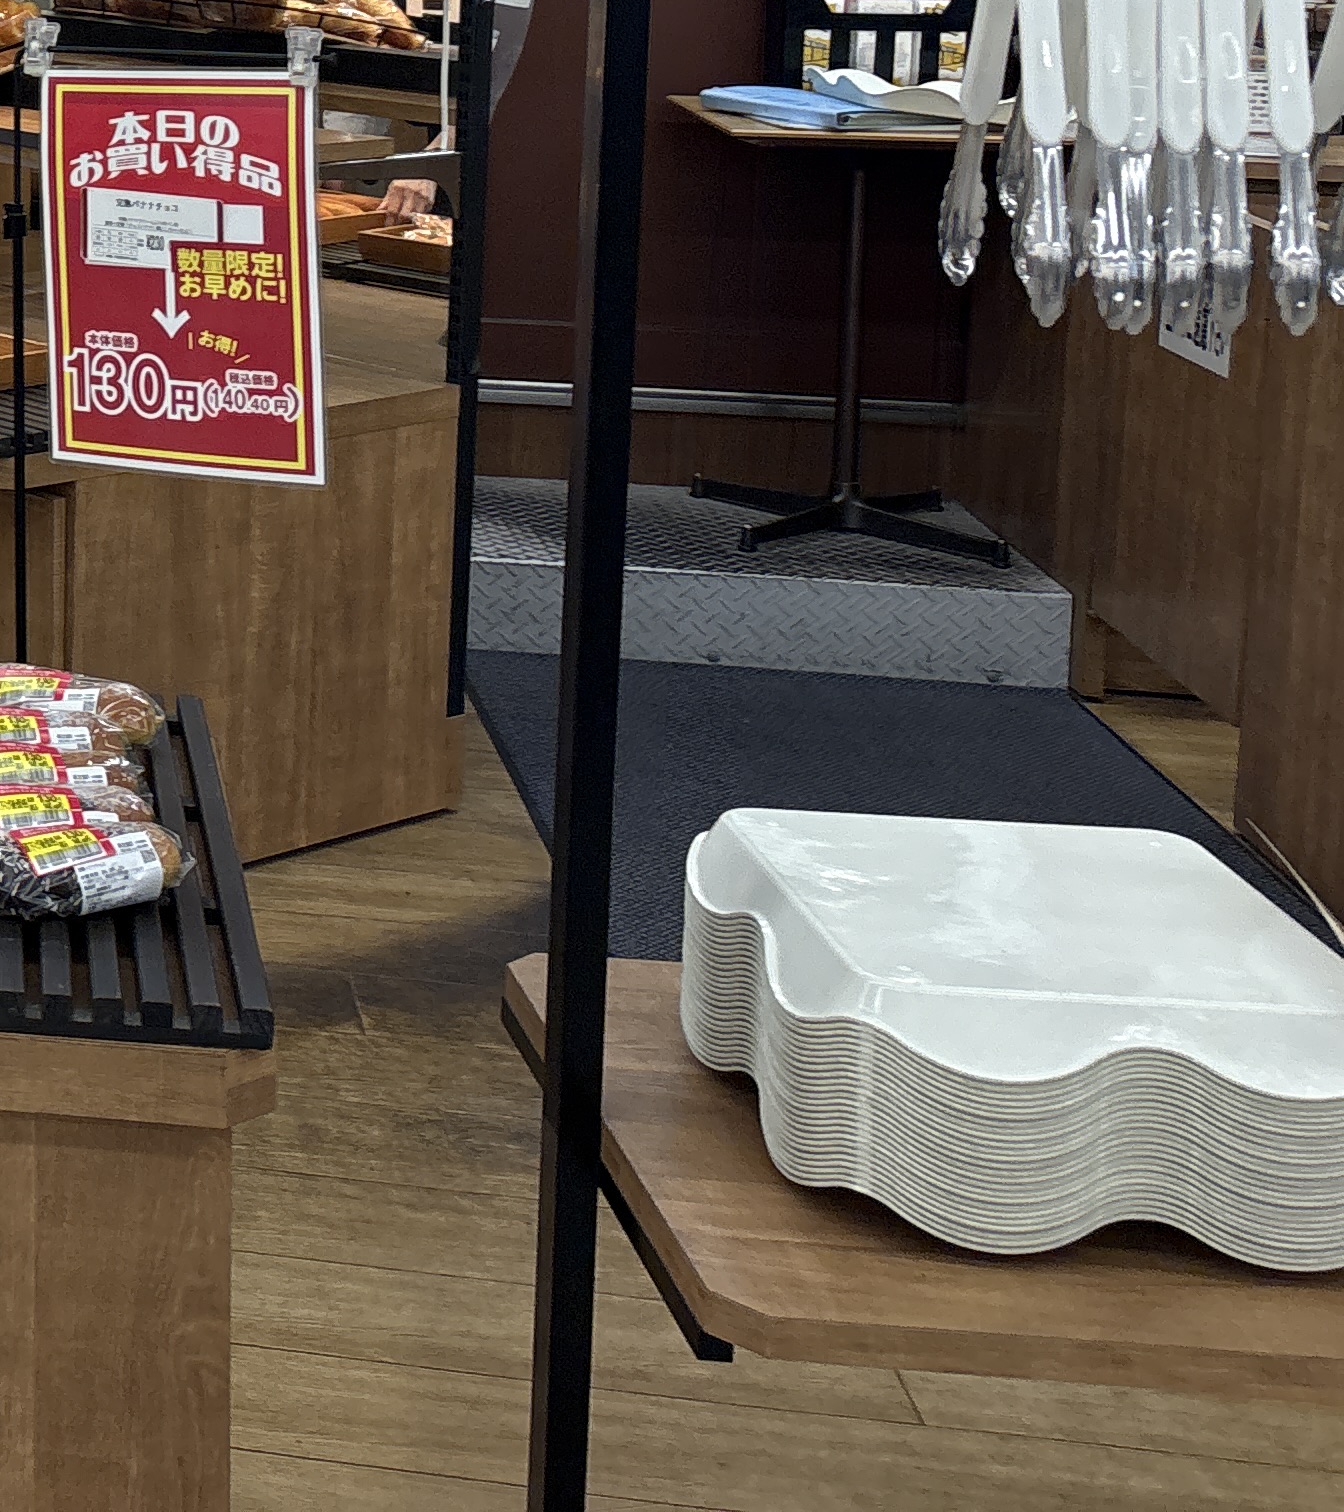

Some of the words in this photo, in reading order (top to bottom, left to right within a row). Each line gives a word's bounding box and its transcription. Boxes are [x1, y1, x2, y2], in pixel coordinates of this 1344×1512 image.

[108, 110, 240, 146] 本日の
[69, 143, 282, 196] お買い得品
[64, 346, 203, 421] 130円
